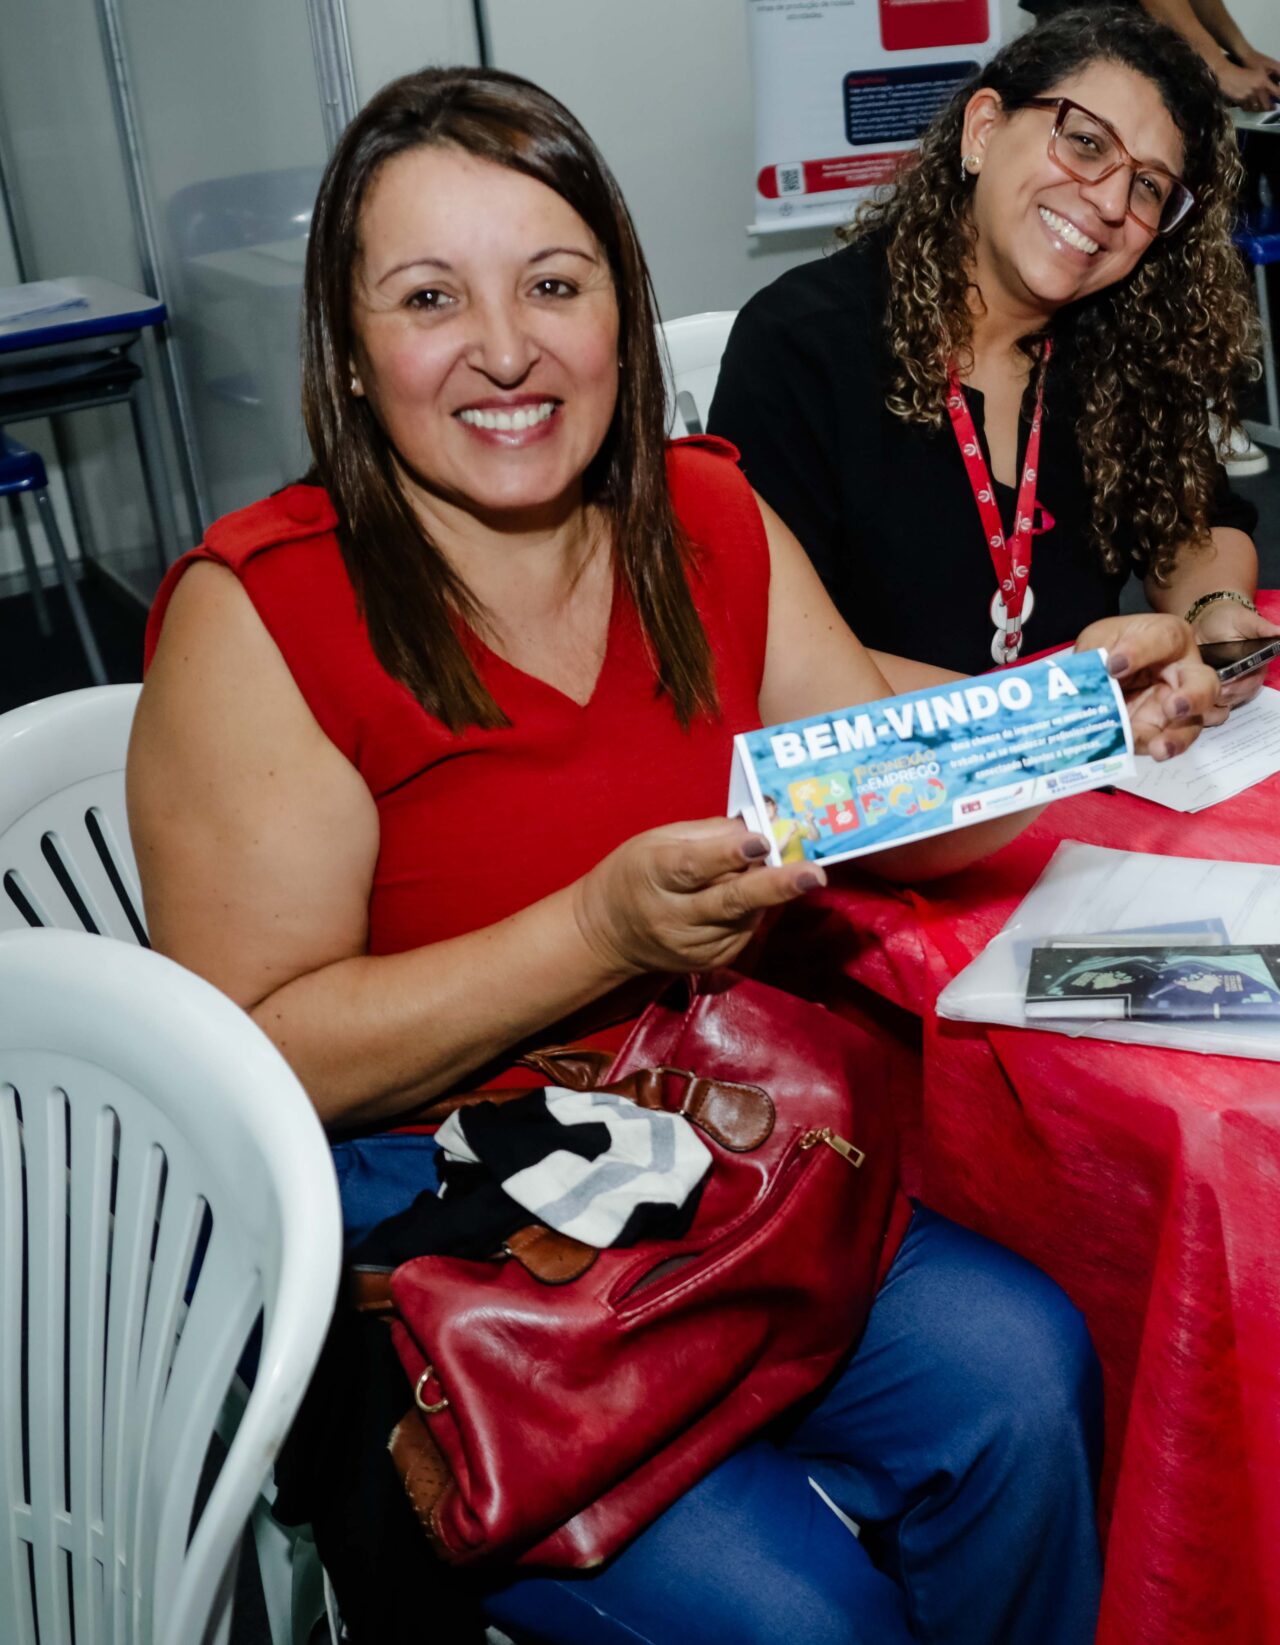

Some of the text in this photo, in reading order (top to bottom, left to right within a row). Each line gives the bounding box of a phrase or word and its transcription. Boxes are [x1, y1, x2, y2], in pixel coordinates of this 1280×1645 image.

[770, 659, 1079, 768] BEM-VINDO À
[867, 762, 940, 788] EMPREGO
